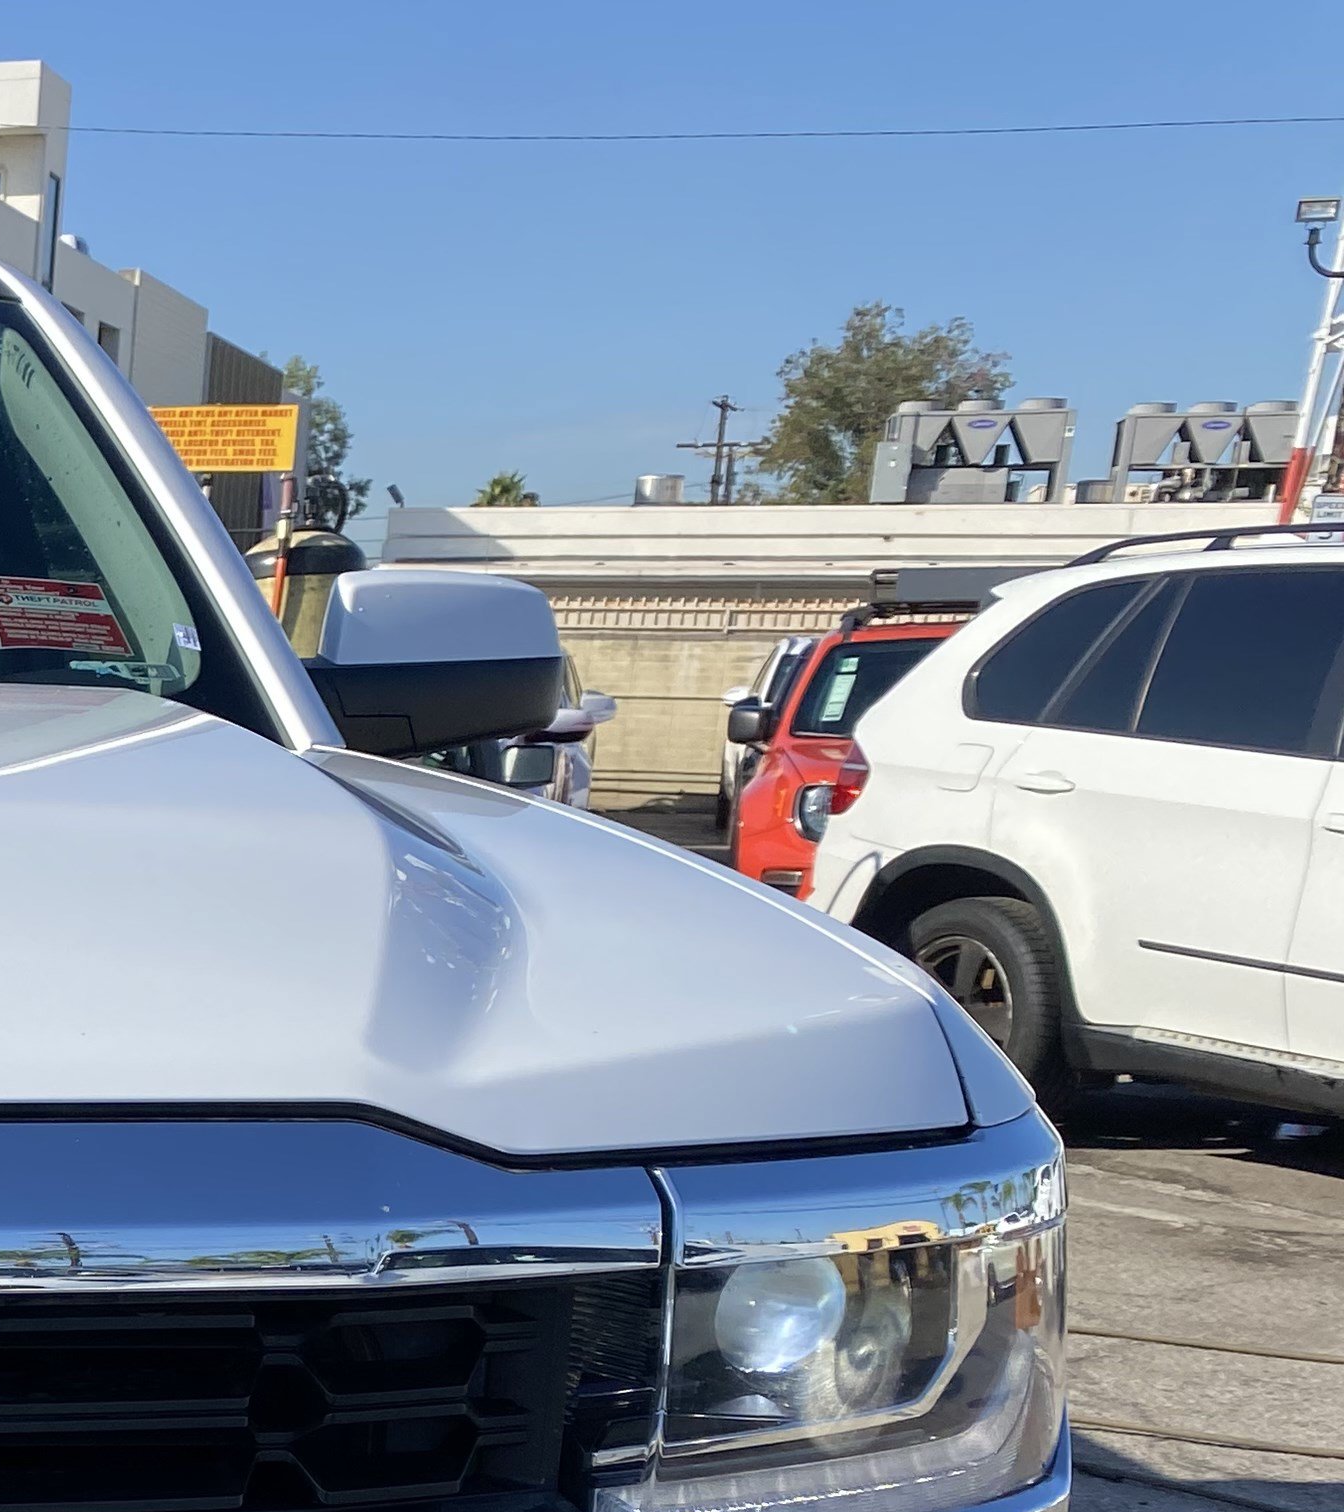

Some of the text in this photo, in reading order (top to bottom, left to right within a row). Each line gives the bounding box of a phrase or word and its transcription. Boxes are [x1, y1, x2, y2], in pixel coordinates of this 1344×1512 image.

[195, 410, 216, 418] PLUS
[217, 409, 233, 418] ANY
[234, 409, 259, 418] AFTER
[260, 409, 293, 417] MARKET
[195, 458, 255, 466] REGISTRATION
[14, 594, 51, 604] THEFT
[52, 597, 98, 608] PATROL
